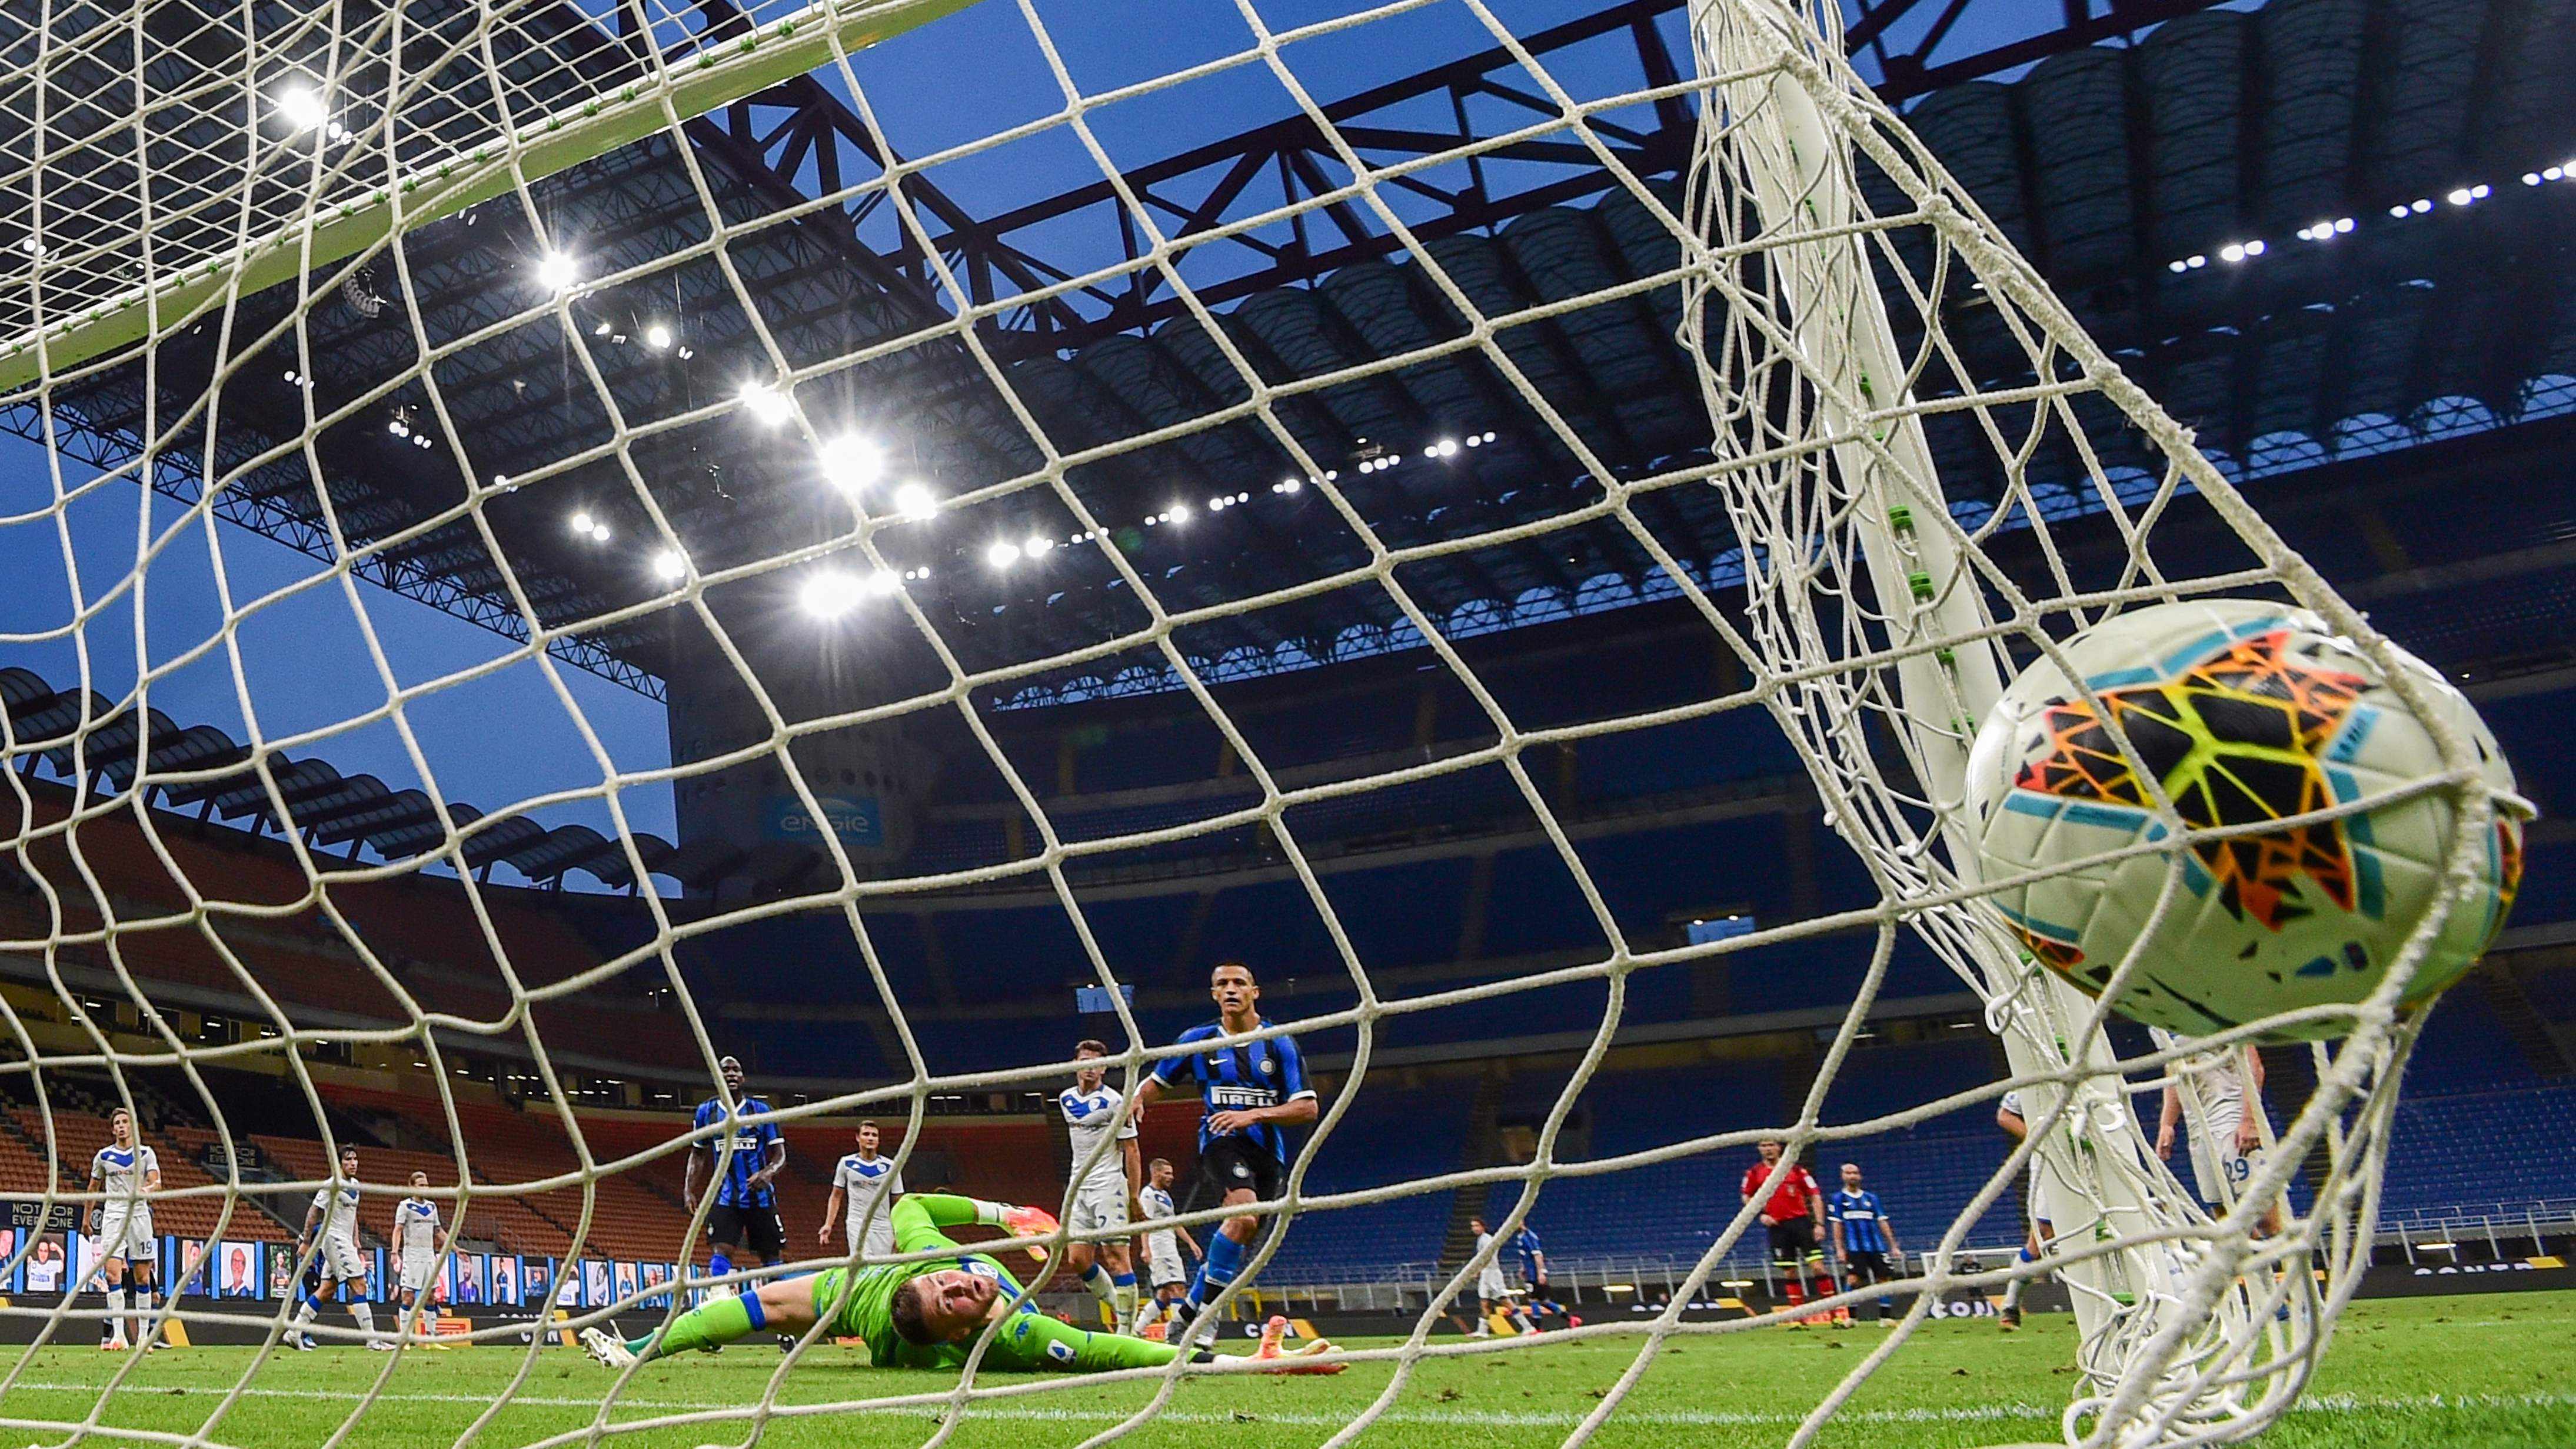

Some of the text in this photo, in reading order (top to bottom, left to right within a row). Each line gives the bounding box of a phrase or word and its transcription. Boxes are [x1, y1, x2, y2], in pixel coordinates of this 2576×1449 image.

[1211, 1086, 1279, 1106] PIRELLI
[47, 1205, 74, 1217] OR
[139, 1241, 152, 1254] 19
